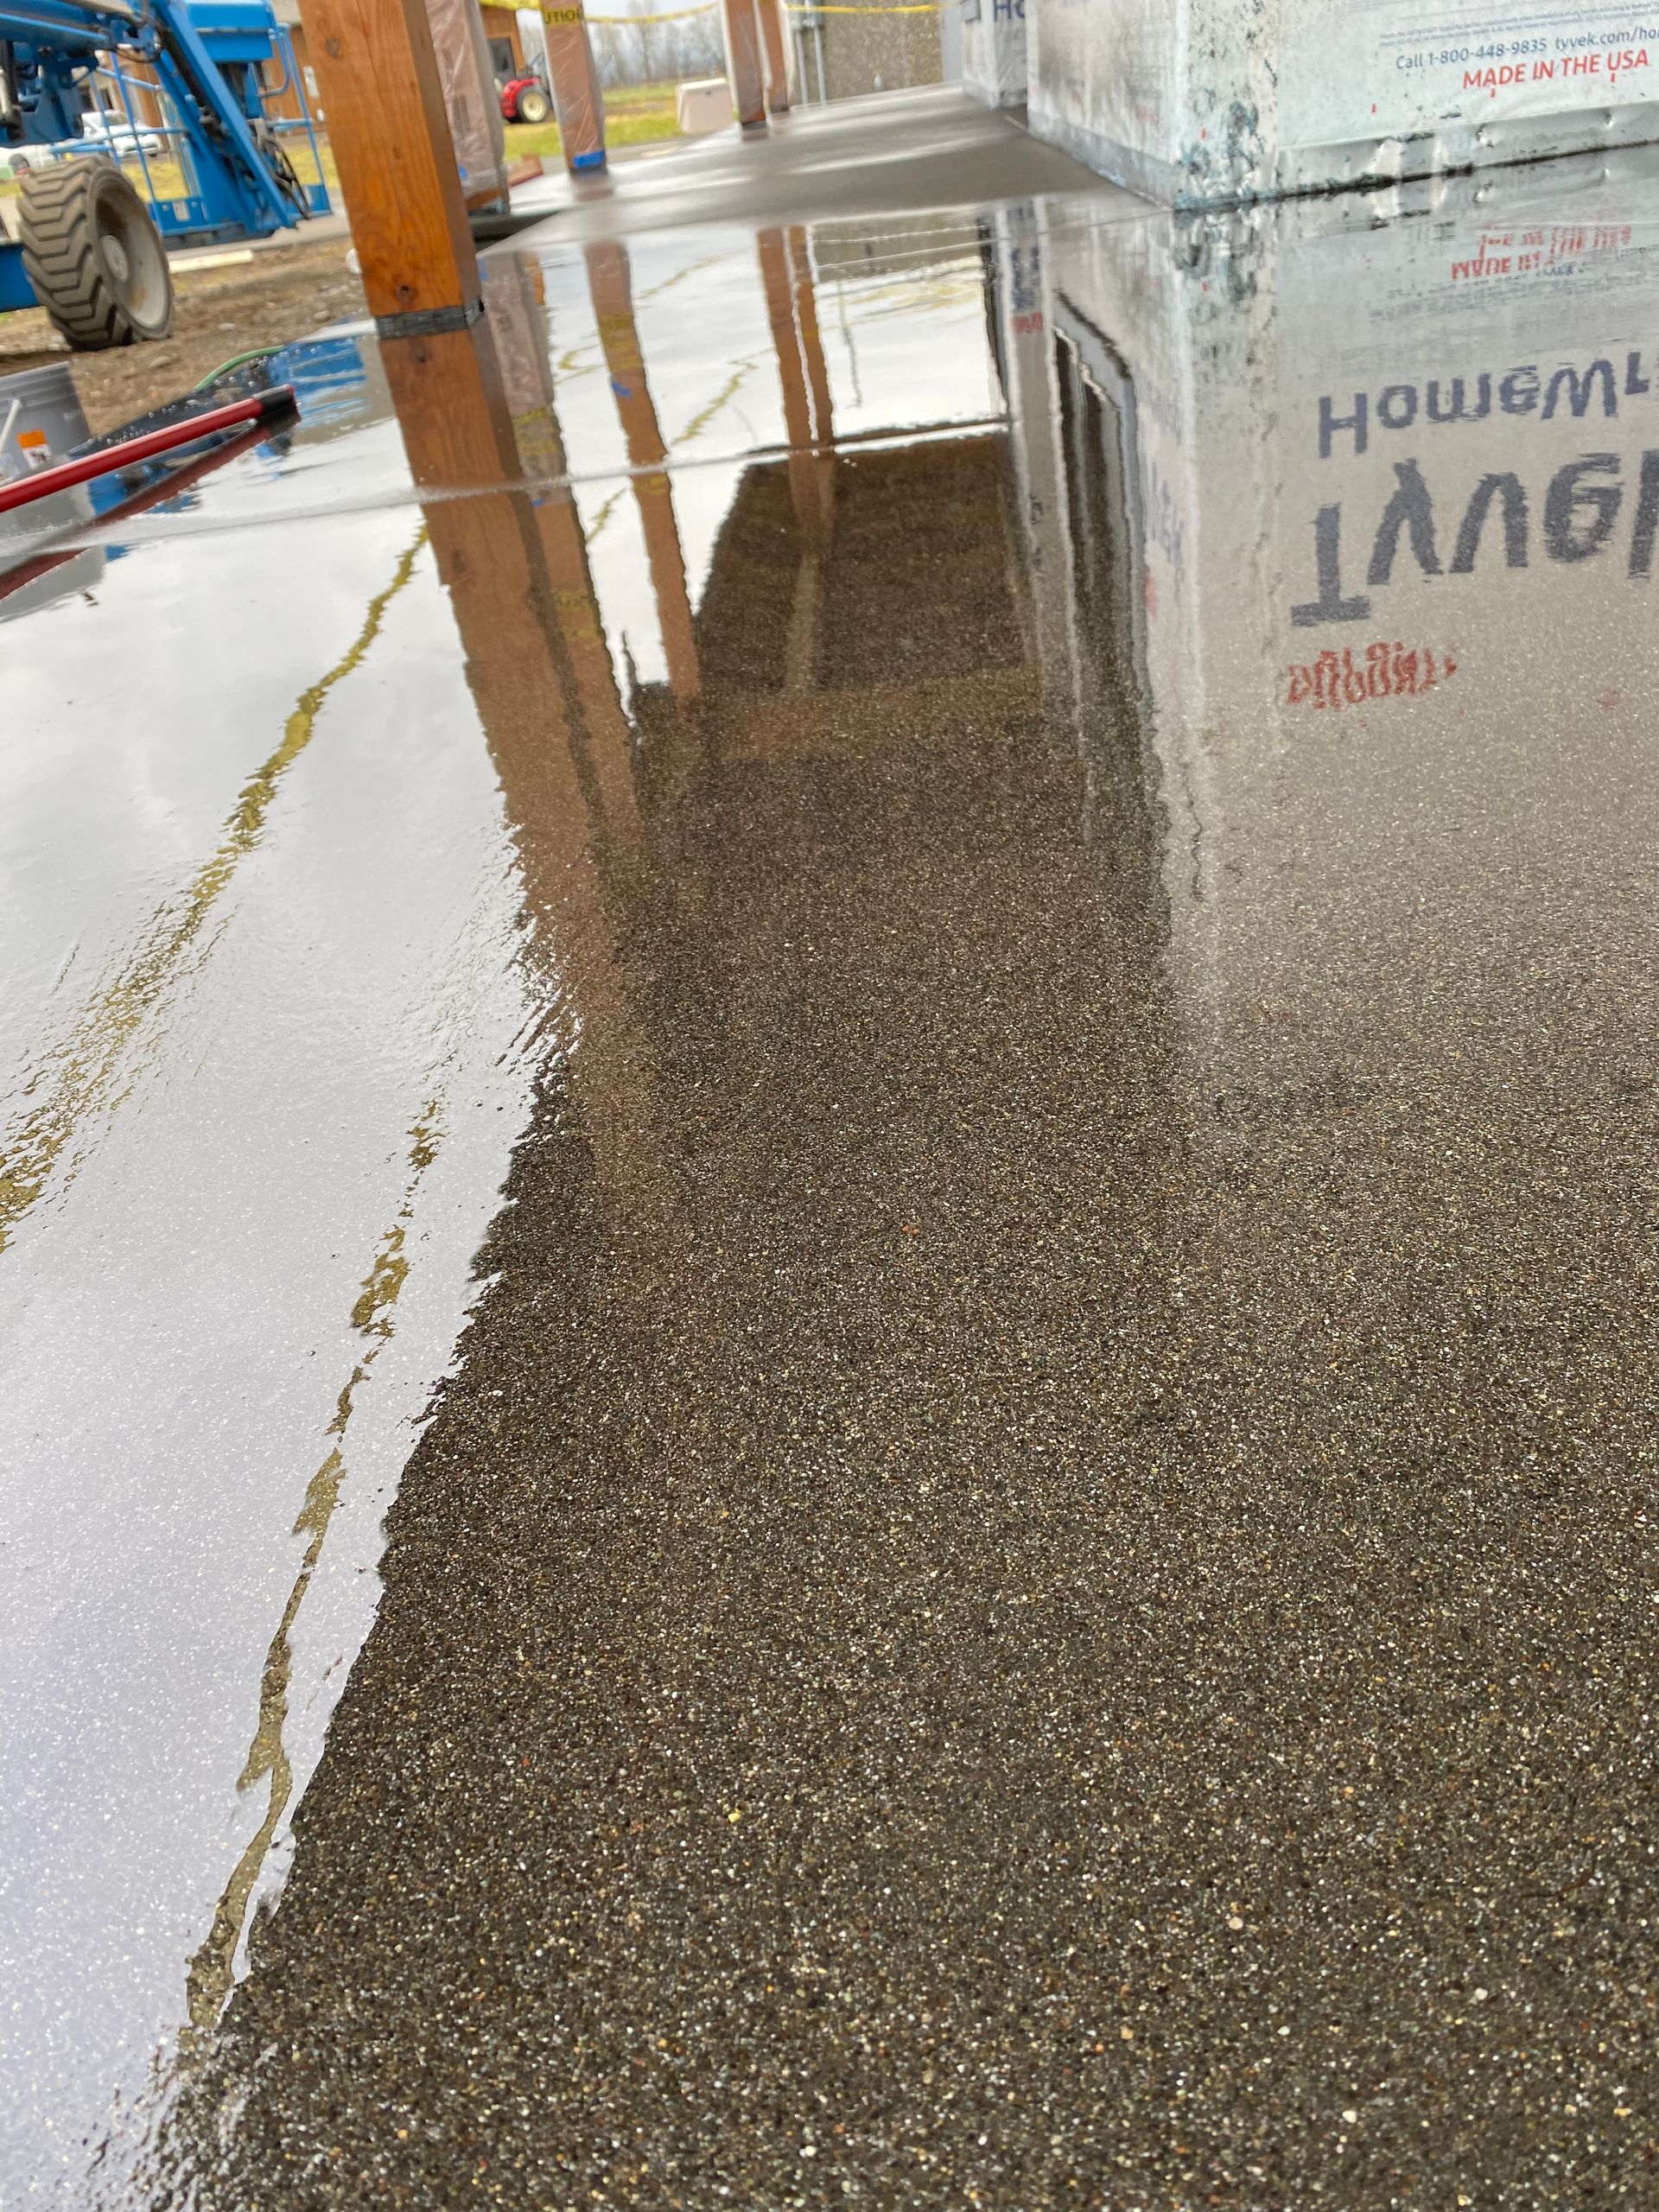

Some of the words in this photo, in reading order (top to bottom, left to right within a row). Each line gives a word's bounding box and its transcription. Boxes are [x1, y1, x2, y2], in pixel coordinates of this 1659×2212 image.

[1396, 52, 1423, 69] Call
[1427, 38, 1547, 66] 1-800-448-9835
[1555, 26, 1659, 51] tyvek.com/ho
[1462, 63, 1526, 90] MADE
[1532, 59, 1554, 80] IN
[1561, 54, 1601, 77] THE
[1607, 48, 1649, 71] USA
